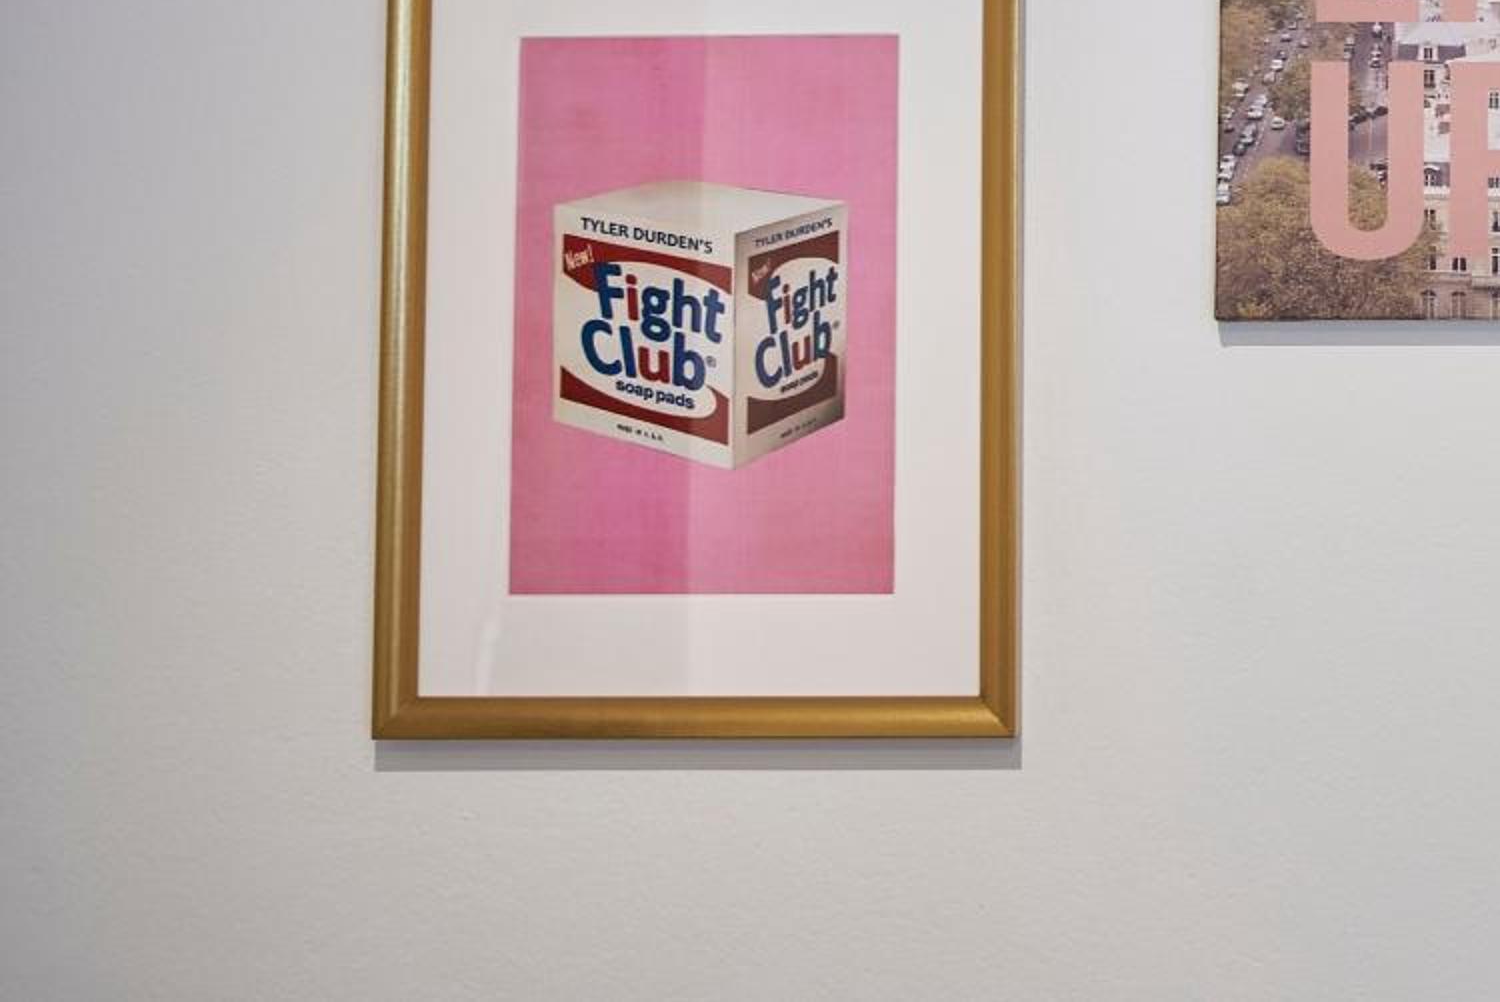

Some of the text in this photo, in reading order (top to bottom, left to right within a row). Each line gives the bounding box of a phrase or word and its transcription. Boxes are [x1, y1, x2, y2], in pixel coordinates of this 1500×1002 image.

[580, 216, 713, 254] TYLER DURDEN'S
[593, 262, 725, 344] Fight
[767, 266, 839, 334] Fight
[581, 319, 706, 391] Club
[755, 309, 832, 389] Club
[615, 380, 695, 409] soap pads
